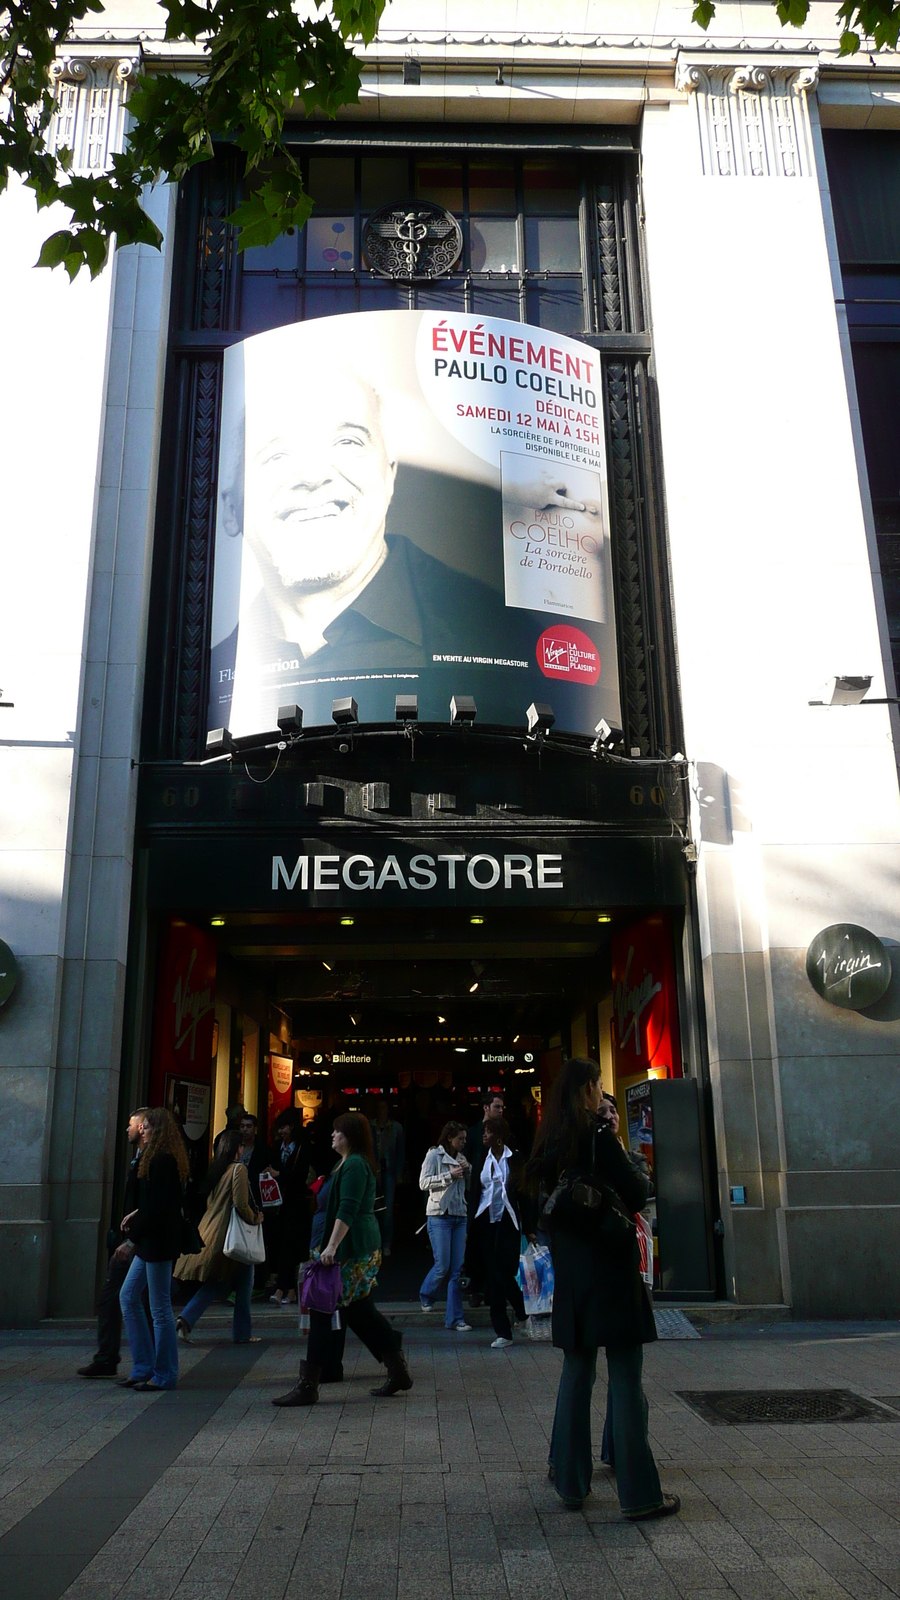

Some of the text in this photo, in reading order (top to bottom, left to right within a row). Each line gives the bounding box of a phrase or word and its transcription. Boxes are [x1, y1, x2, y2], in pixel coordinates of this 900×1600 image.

[432, 320, 594, 384] ÉVÉNEMENT
[434, 358, 597, 409] PAULO COELHO
[456, 404, 600, 445] SAMEDI 12 MAI À 15H
[536, 400, 599, 429] DÉDICACE
[490, 426, 601, 458] LA SORCIÈRE DE PORTOBELLO
[525, 443, 601, 468] DISPONIBLE LE 4 MAI
[534, 510, 575, 530] PAULO
[510, 520, 598, 554] COELHO
[524, 542, 588, 564] La sorcière
[520, 556, 593, 580] de Portobello
[545, 641, 567, 664] Virgin
[569, 642, 577, 650] LA
[569, 650, 596, 660] CULTURE
[432, 654, 442, 662] EN
[442, 655, 463, 663] VENTE
[472, 657, 494, 665] VIRGIN
[493, 658, 529, 668] MEGASTORE
[629, 785, 665, 806] 60
[270, 853, 565, 891] MEGASTORE
[816, 933, 882, 999] Virgin
[172, 947, 216, 1061] Virgin
[614, 945, 663, 1057] Virgin
[332, 1053, 372, 1064] Billetterie
[481, 1052, 515, 1063] Librairie
